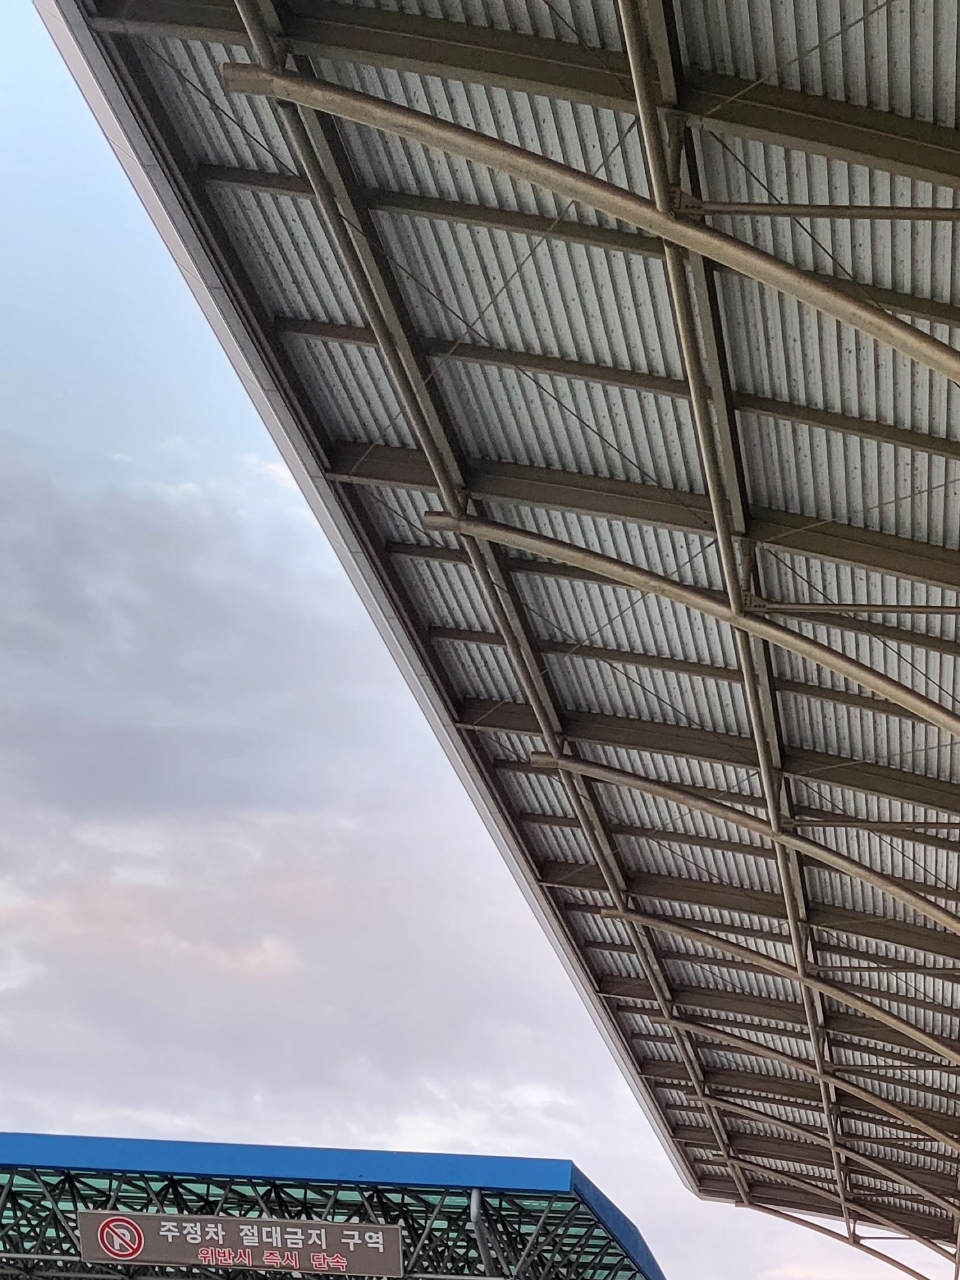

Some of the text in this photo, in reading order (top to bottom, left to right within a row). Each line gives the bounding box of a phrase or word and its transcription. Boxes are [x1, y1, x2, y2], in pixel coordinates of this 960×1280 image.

[158, 1221, 385, 1253] 주정차 절대금지 구역
[198, 1247, 348, 1272] 위반시 즉시 단속
